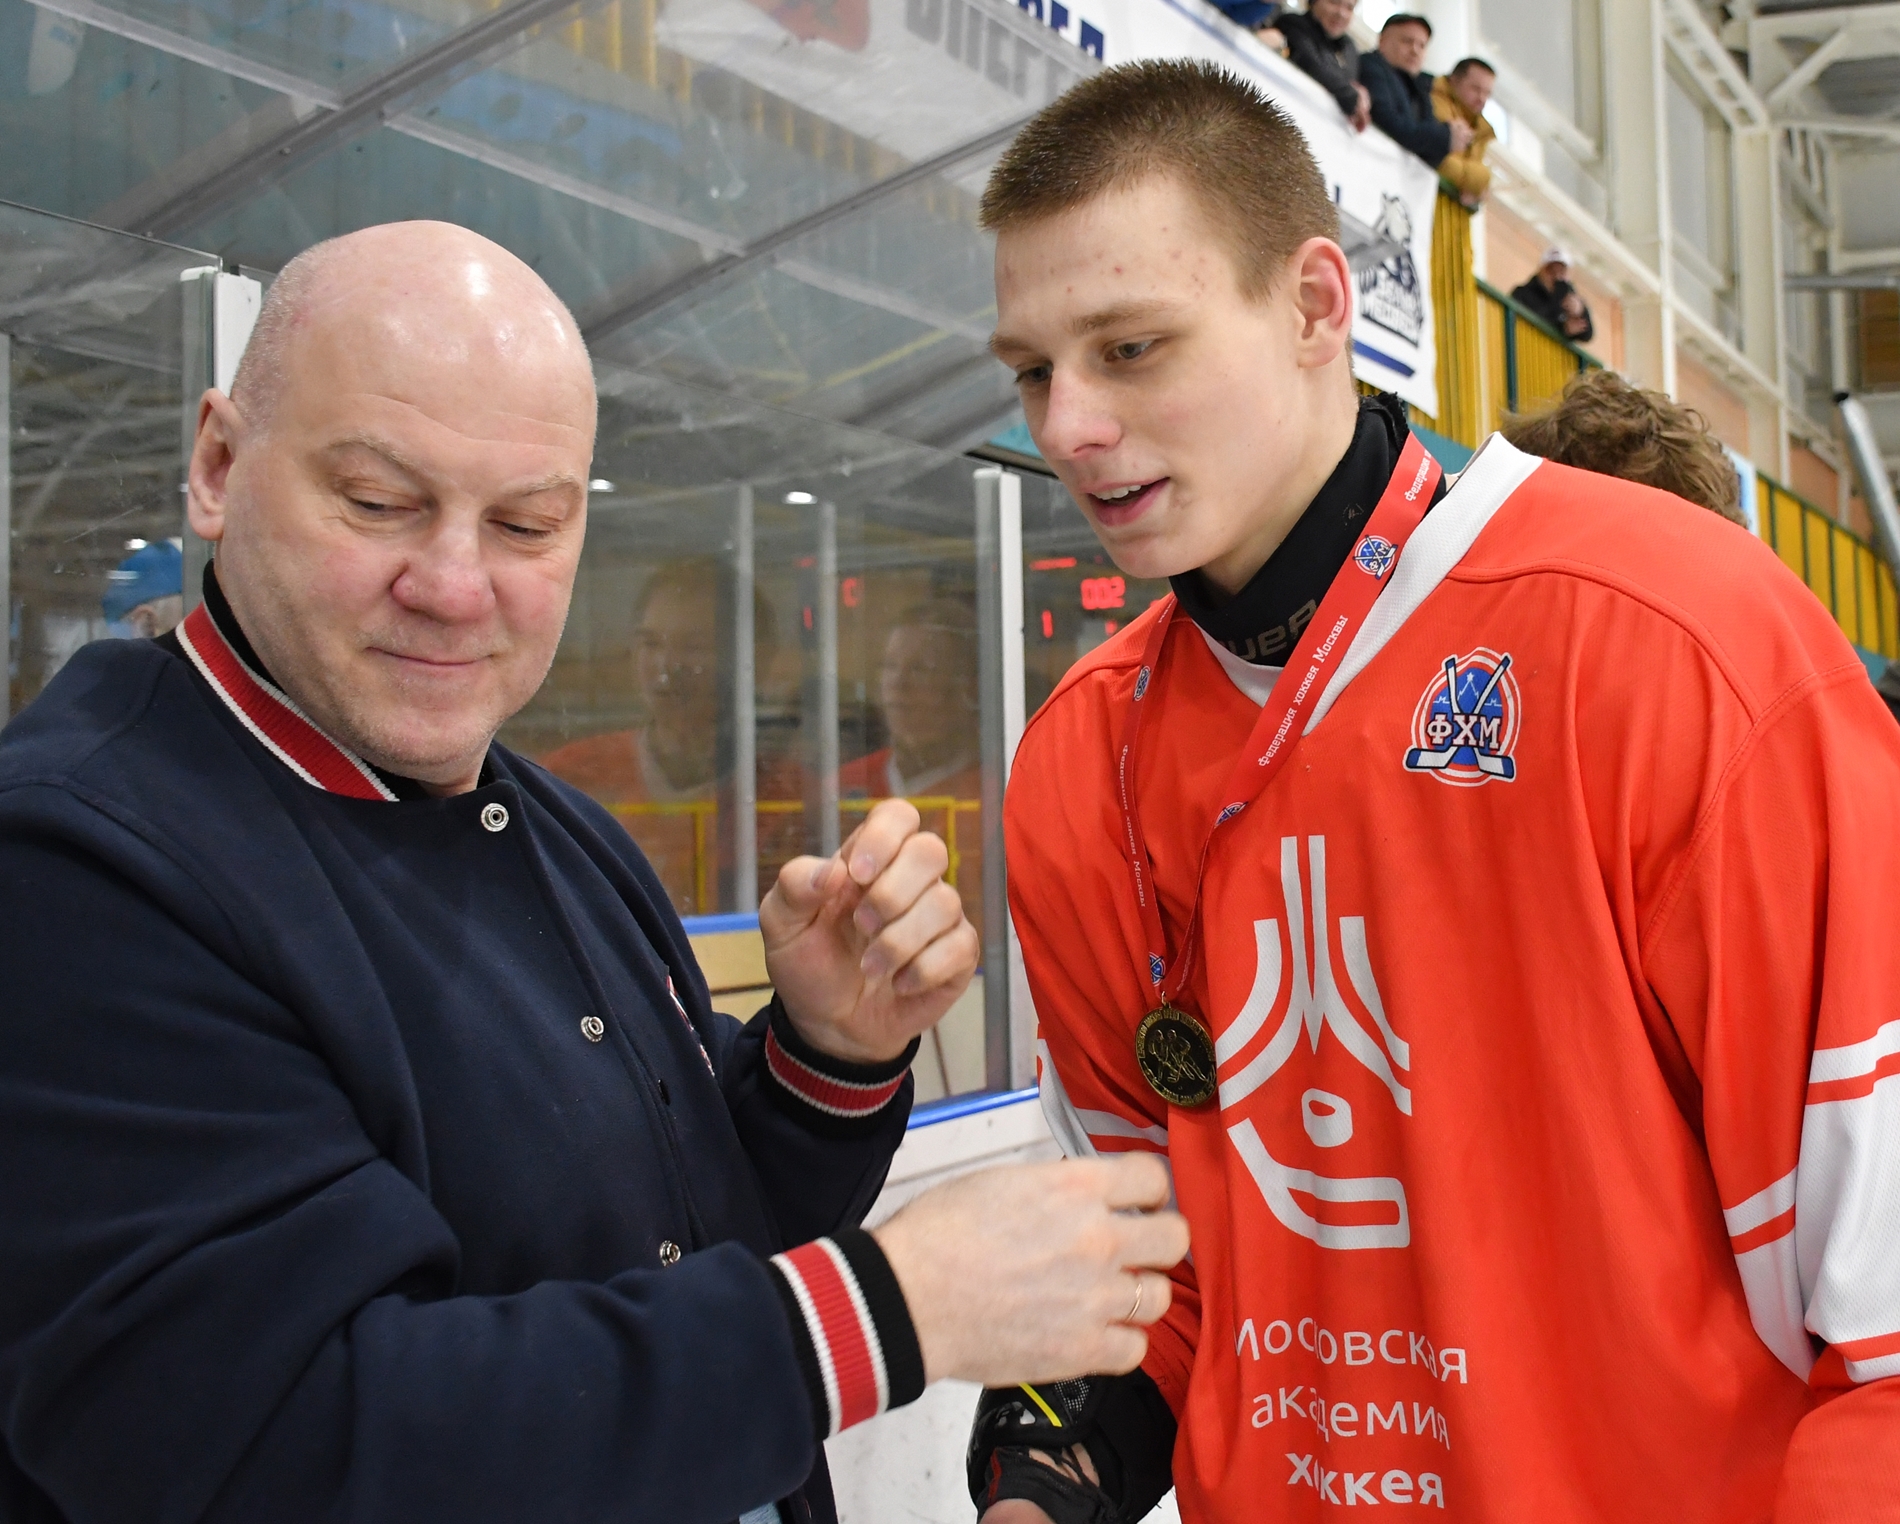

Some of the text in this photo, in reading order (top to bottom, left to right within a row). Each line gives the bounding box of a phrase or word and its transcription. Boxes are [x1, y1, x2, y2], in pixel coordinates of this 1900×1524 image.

[1257, 615, 1348, 767] Федерация хоккея Москвы
[1426, 712, 1502, 751] ФХМ
[1133, 860, 1145, 907] Москвы
[1234, 1316, 1468, 1384] Мосовская
[1251, 1385, 1450, 1451] академия
